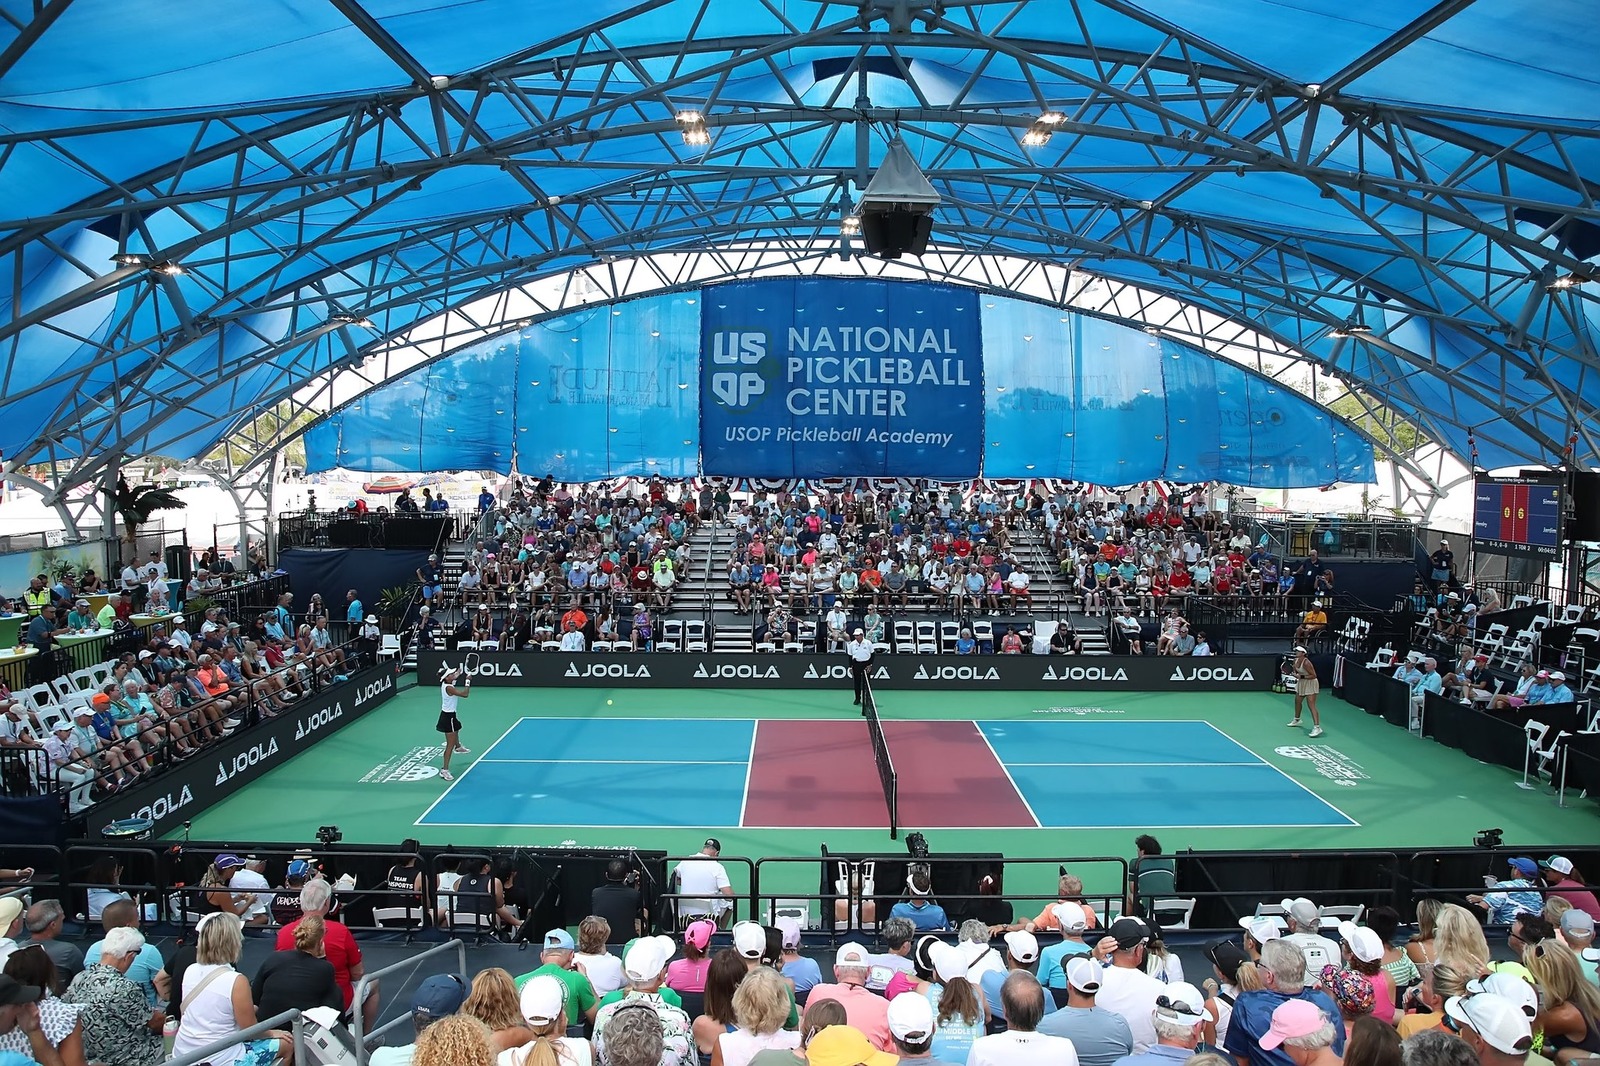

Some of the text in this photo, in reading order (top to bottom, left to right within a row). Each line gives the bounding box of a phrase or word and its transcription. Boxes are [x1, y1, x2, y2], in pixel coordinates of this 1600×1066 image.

[713, 332, 766, 364] US
[788, 326, 957, 354] NATIONAL
[787, 357, 970, 386] PICKLEBALL
[786, 388, 907, 417] CENTER
[725, 427, 953, 447] USOP Pickleball Academy
[1517, 507, 1524, 519] 6
[580, 663, 651, 678] JOOLA
[710, 664, 780, 679] JOOLA
[930, 665, 1001, 680] JOOLA
[1058, 666, 1129, 681] JOOLA
[1186, 667, 1255, 681] JOOLA
[361, 674, 392, 703] JOOLA
[308, 701, 343, 734] JOOLA
[229, 736, 279, 779] JOOLA
